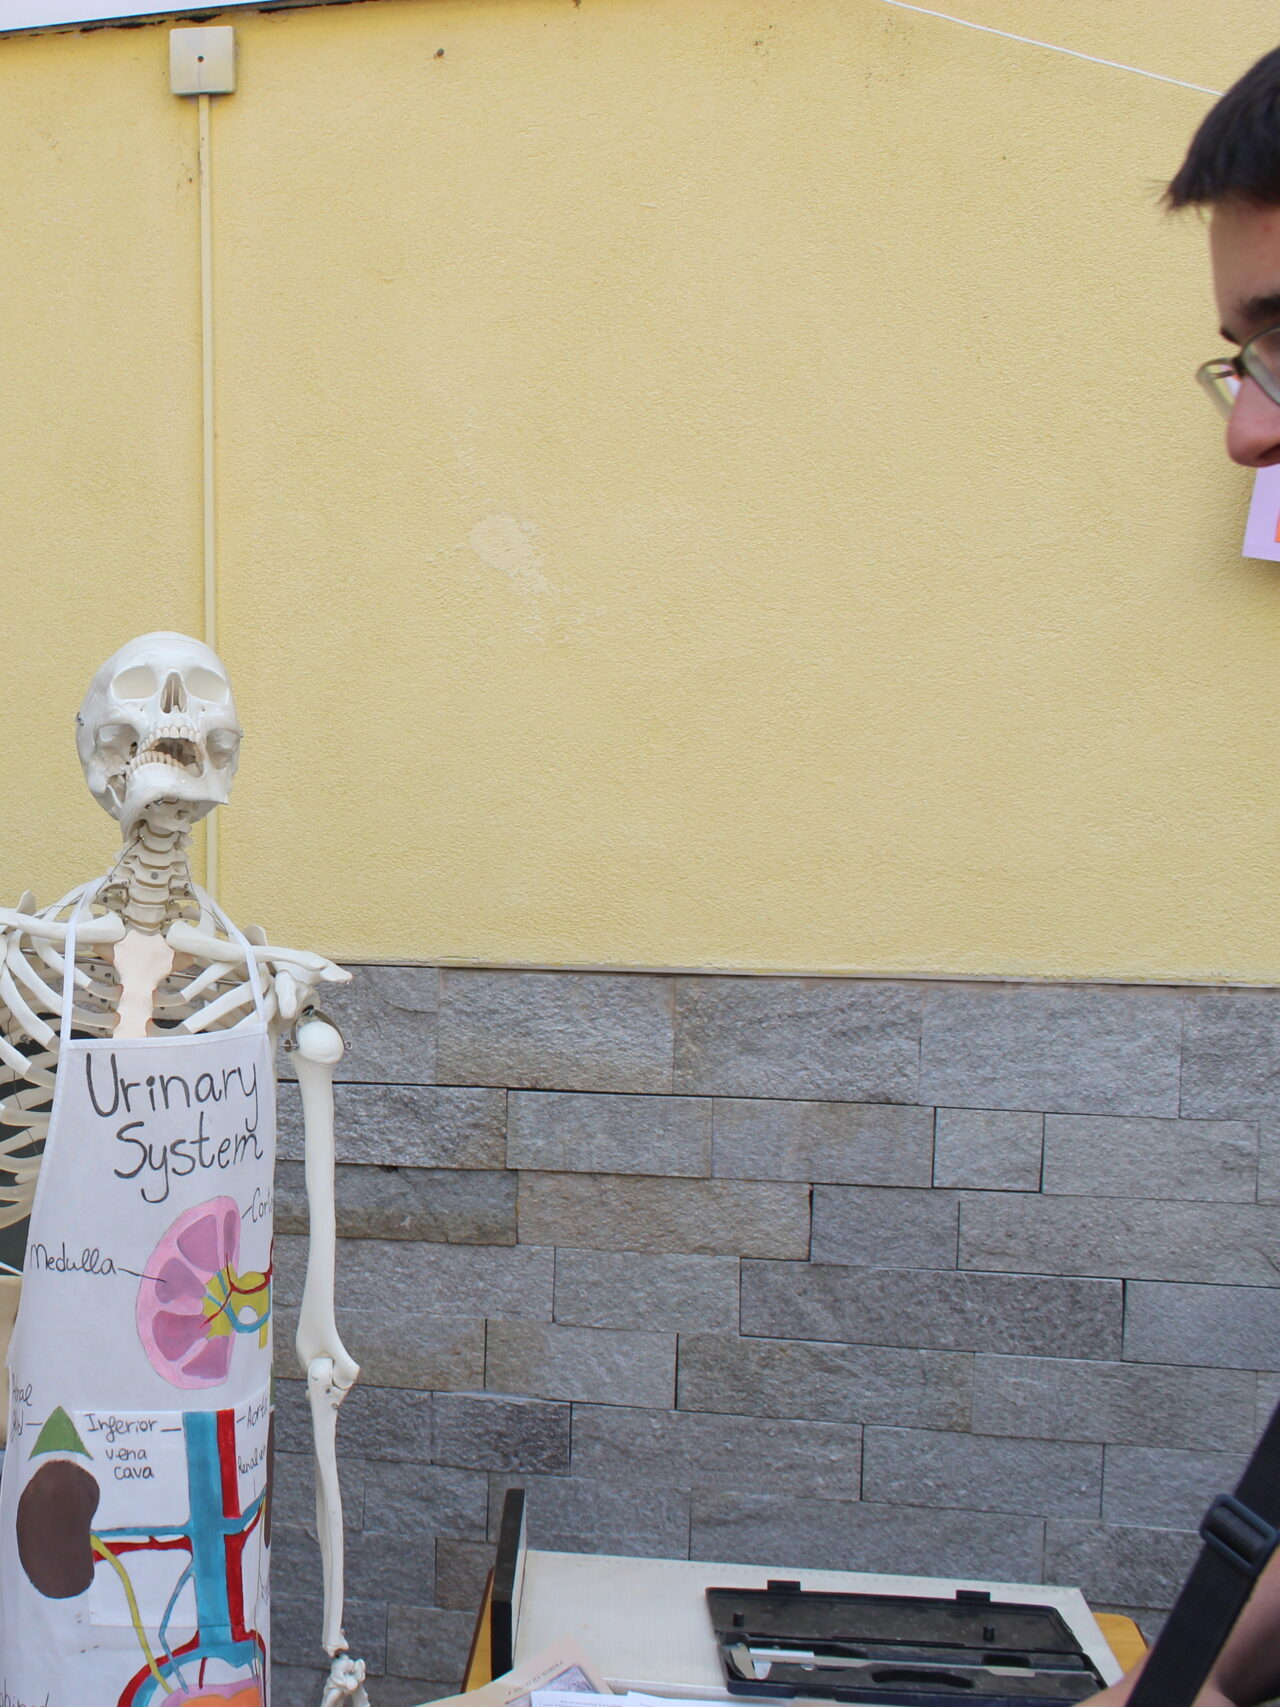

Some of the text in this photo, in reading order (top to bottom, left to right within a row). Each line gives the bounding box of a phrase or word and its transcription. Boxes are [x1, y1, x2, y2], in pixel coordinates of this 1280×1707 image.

[85, 1052, 259, 1132] Urinary
[113, 1111, 264, 1204] System
[30, 1241, 117, 1276] Medulla
[83, 1412, 158, 1443] Inferior
[105, 1447, 148, 1461] vena
